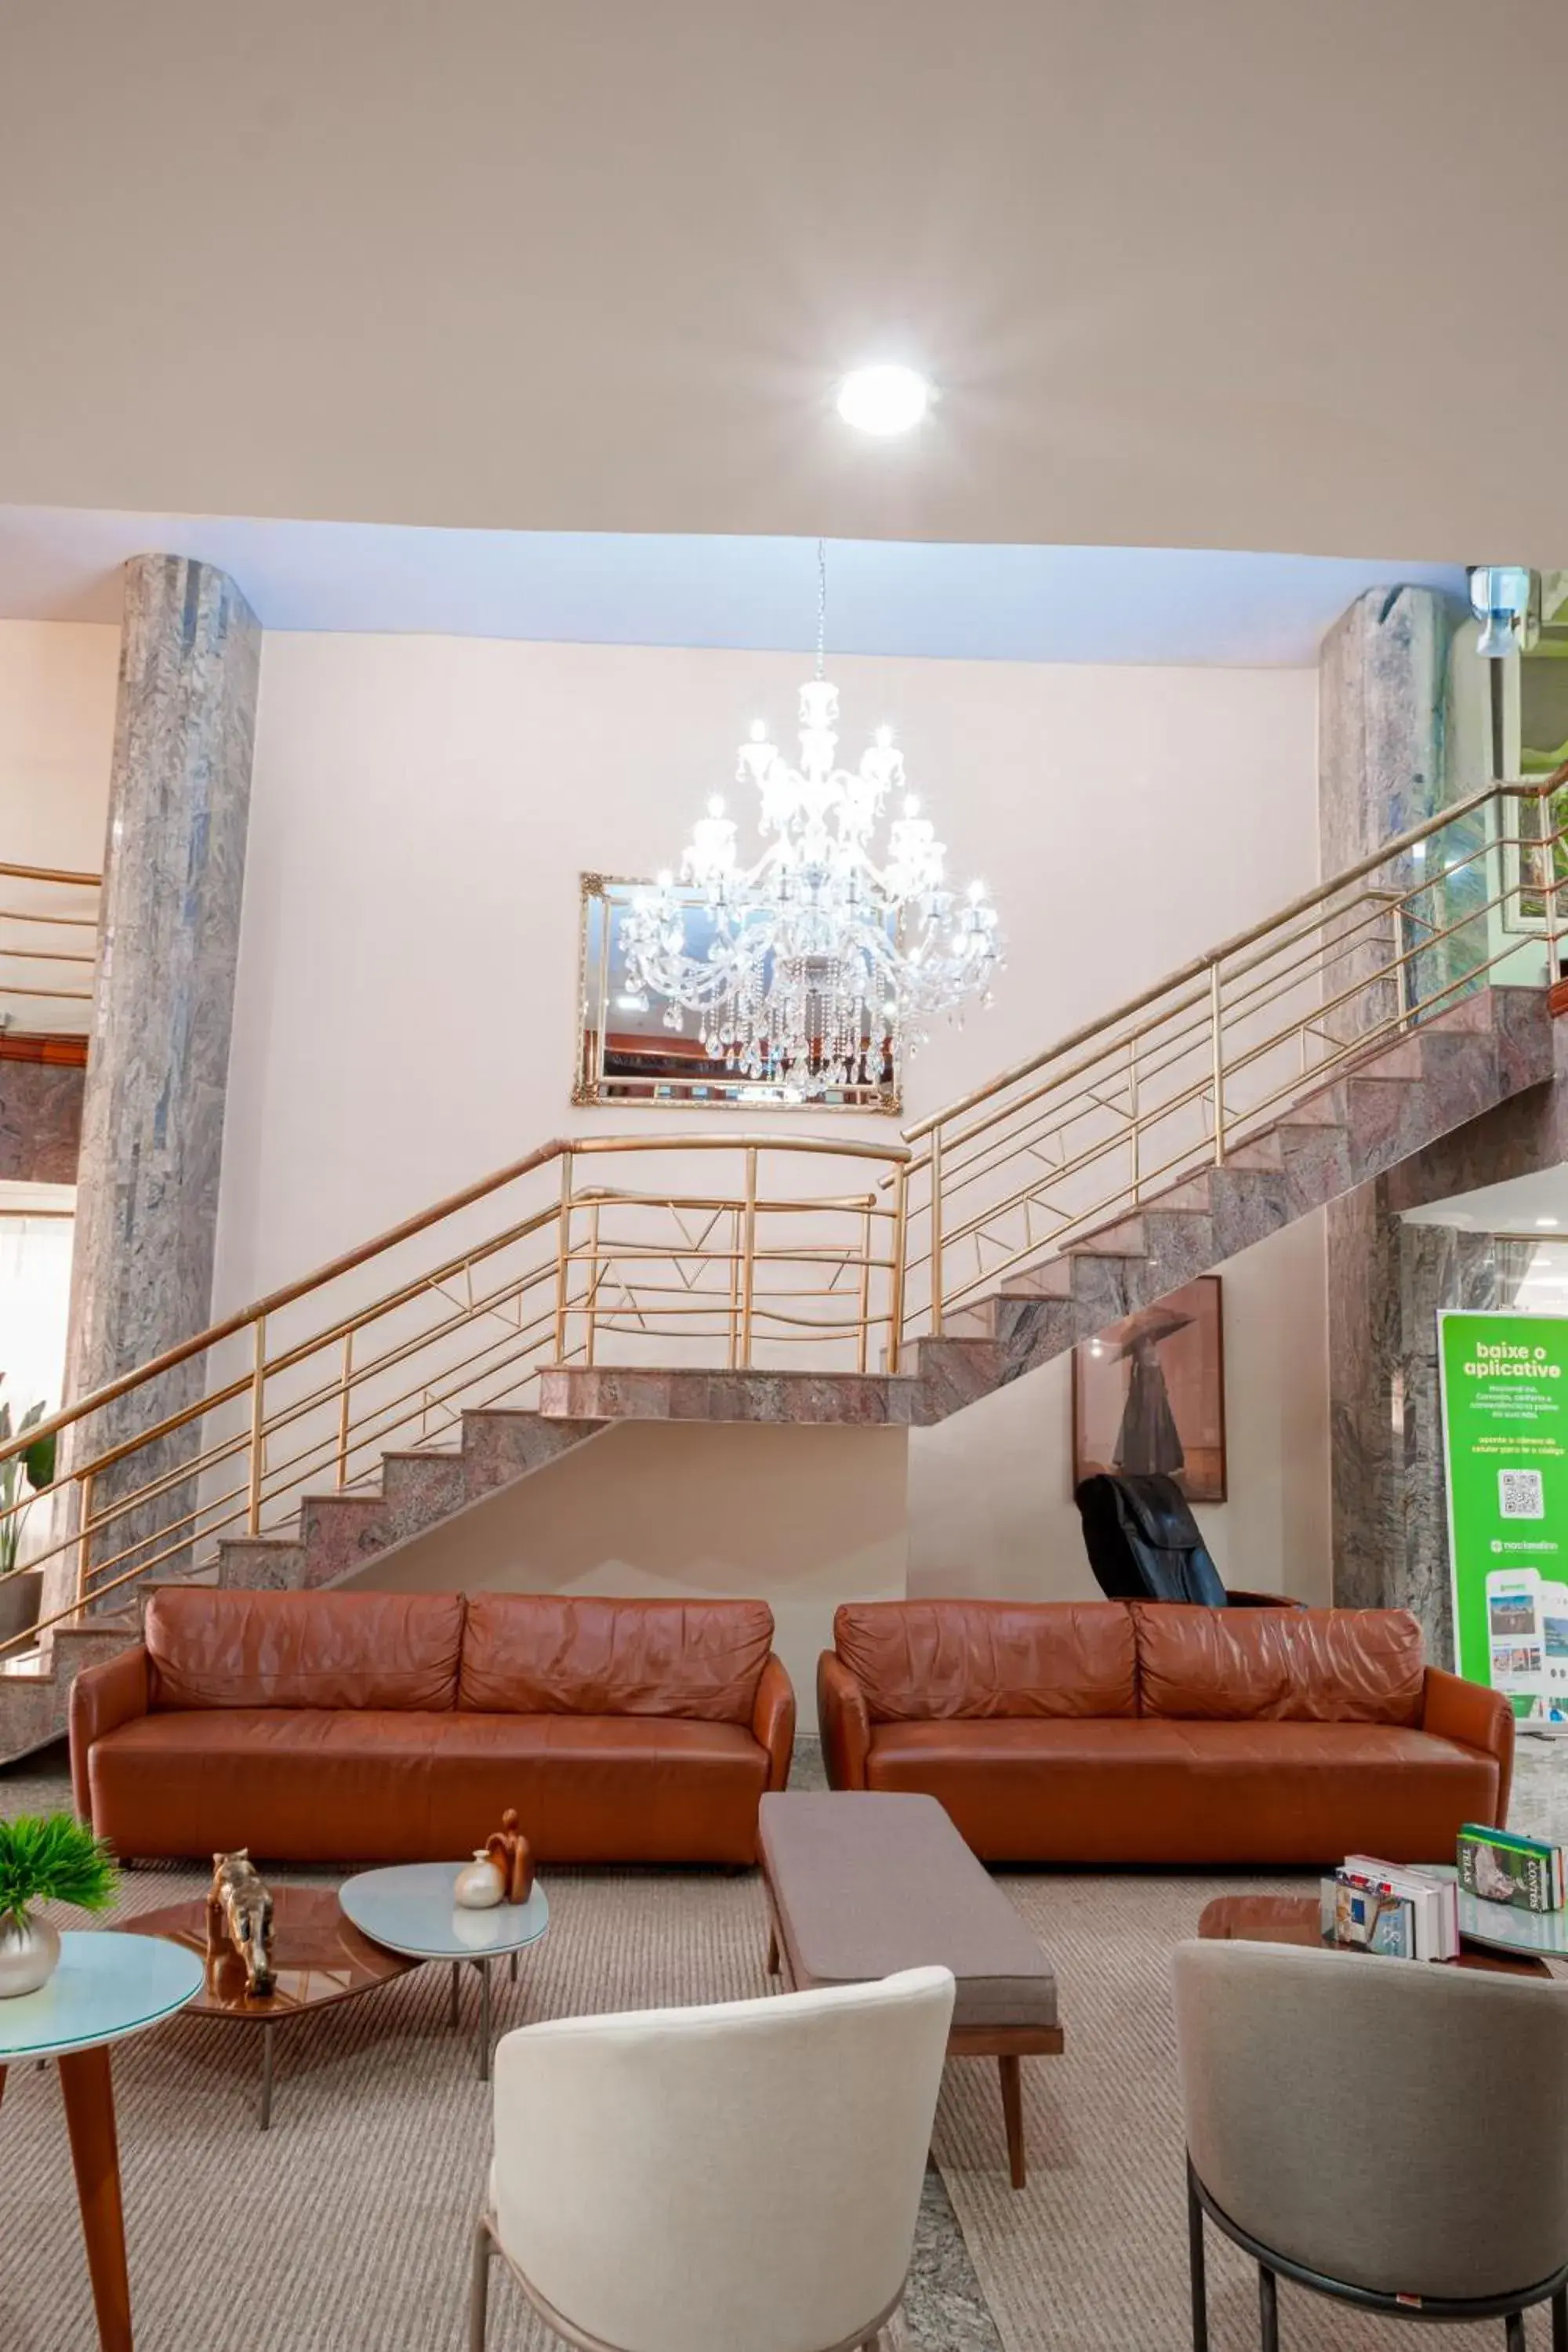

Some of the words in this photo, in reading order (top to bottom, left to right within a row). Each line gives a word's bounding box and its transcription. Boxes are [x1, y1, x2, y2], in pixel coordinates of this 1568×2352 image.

[1476, 1342, 1529, 1359] baixe
[1534, 1347, 1547, 1359] o
[1464, 1360, 1562, 1378] aplicativo
